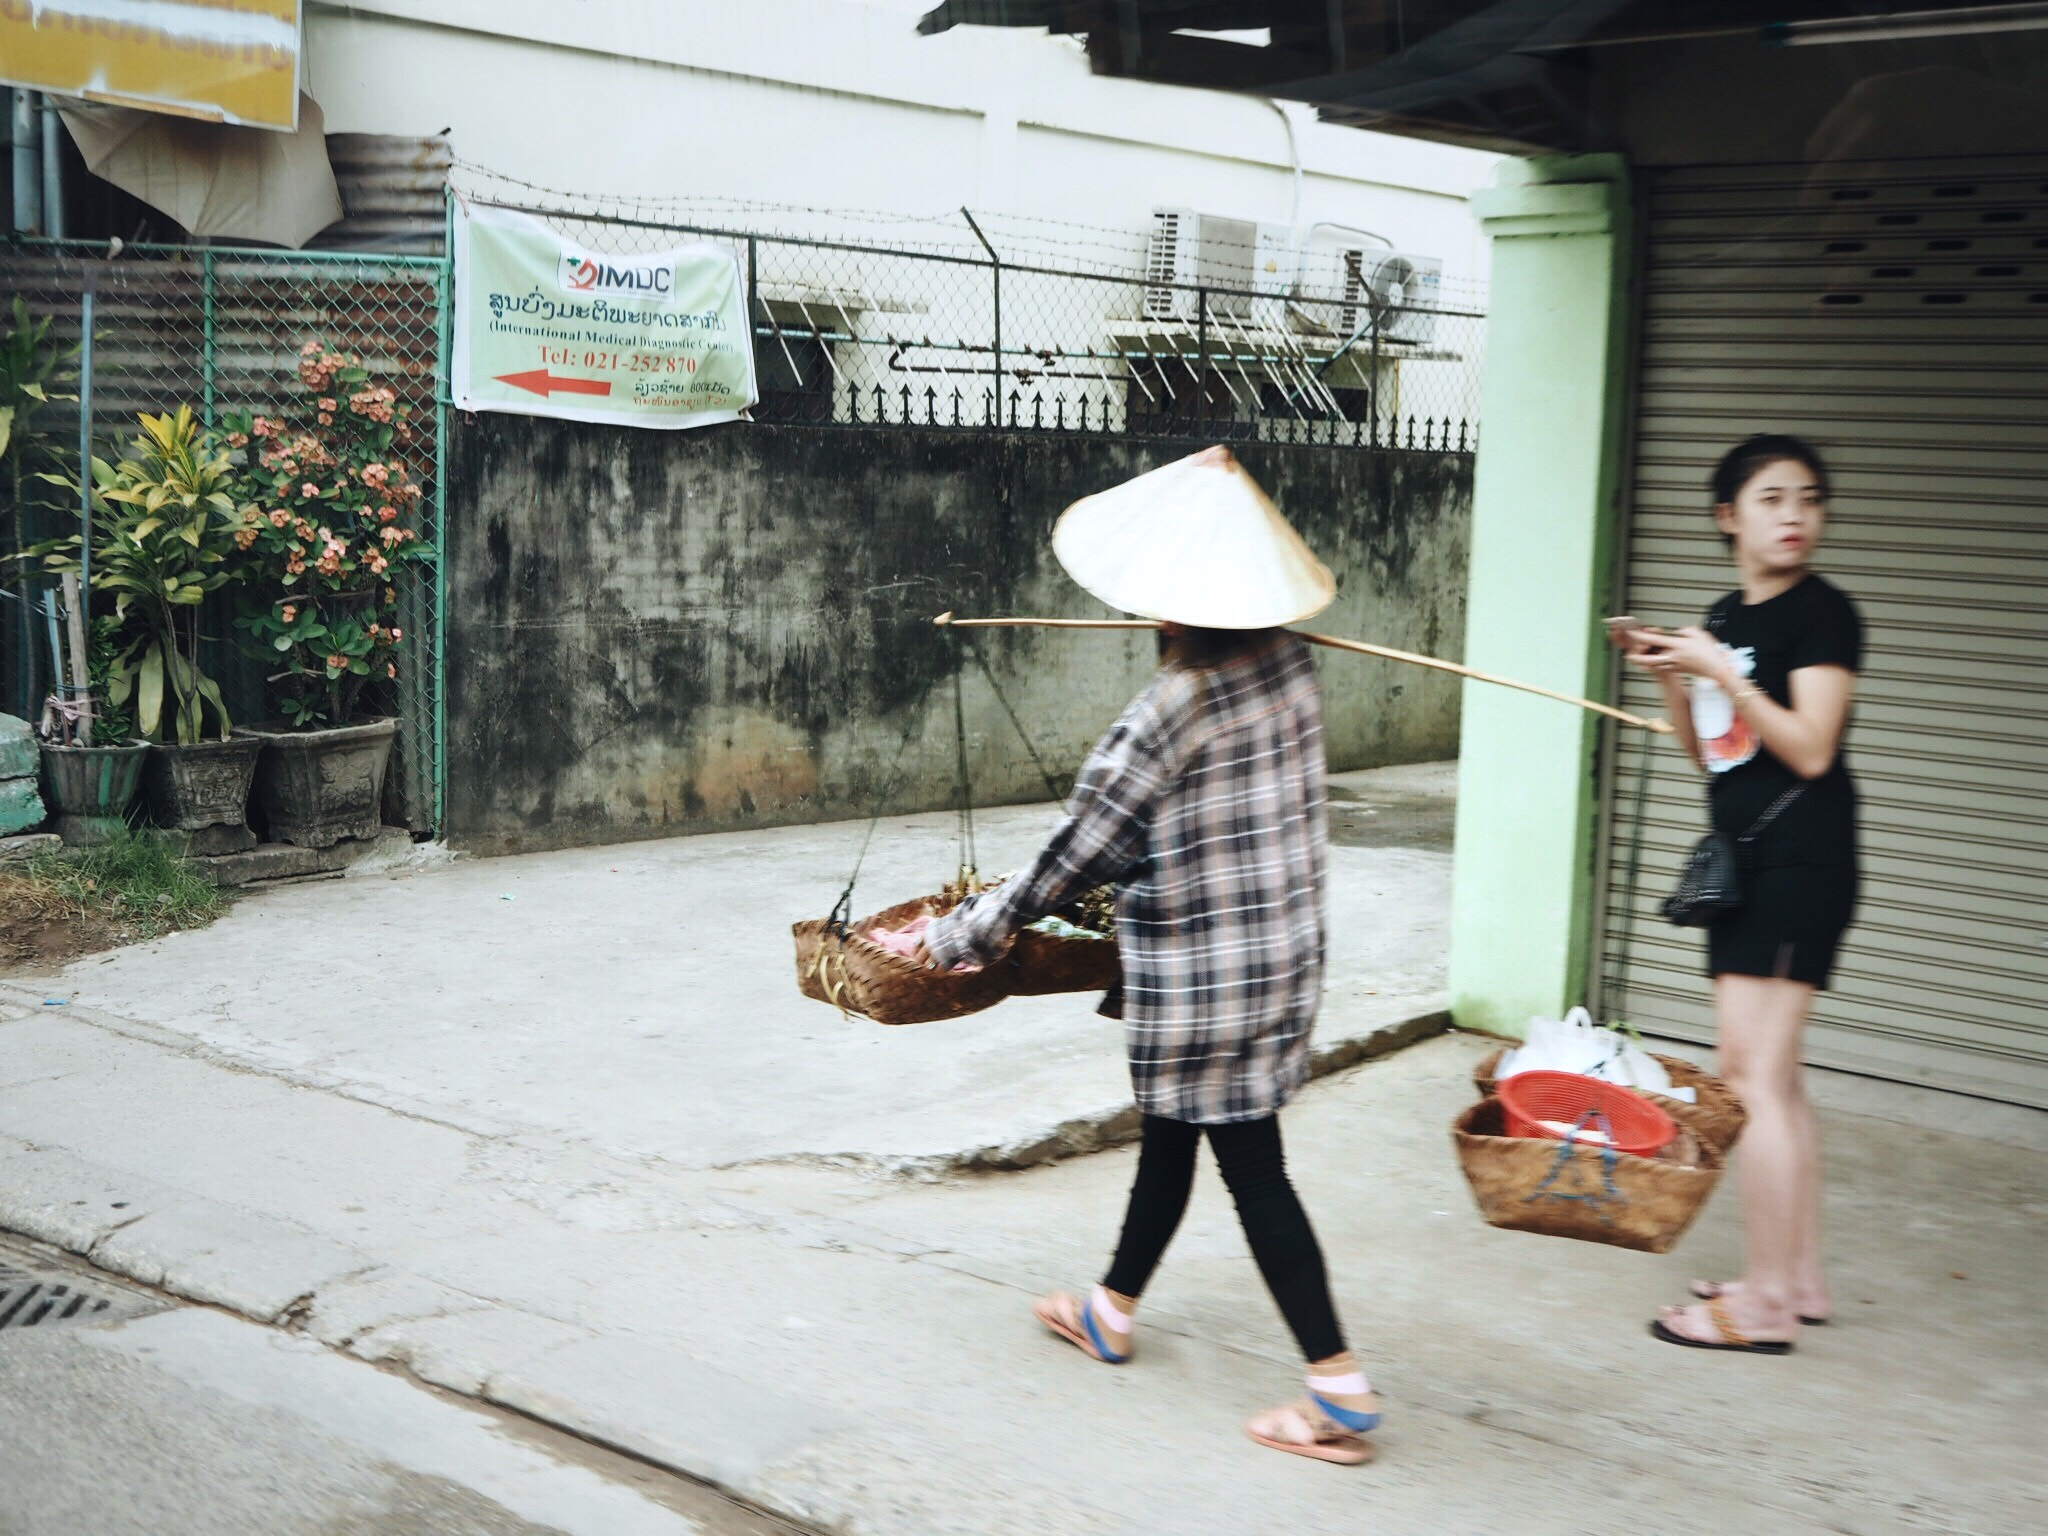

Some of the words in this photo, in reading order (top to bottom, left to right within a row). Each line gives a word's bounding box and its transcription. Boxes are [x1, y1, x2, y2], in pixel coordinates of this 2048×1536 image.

[597, 263, 670, 293] IMDC
[489, 320, 581, 342] (International
[585, 331, 636, 347] Medical
[640, 335, 696, 350] Diagnostic
[538, 345, 576, 366] Tel:
[584, 351, 661, 374] 021-252
[666, 357, 697, 374] 870
